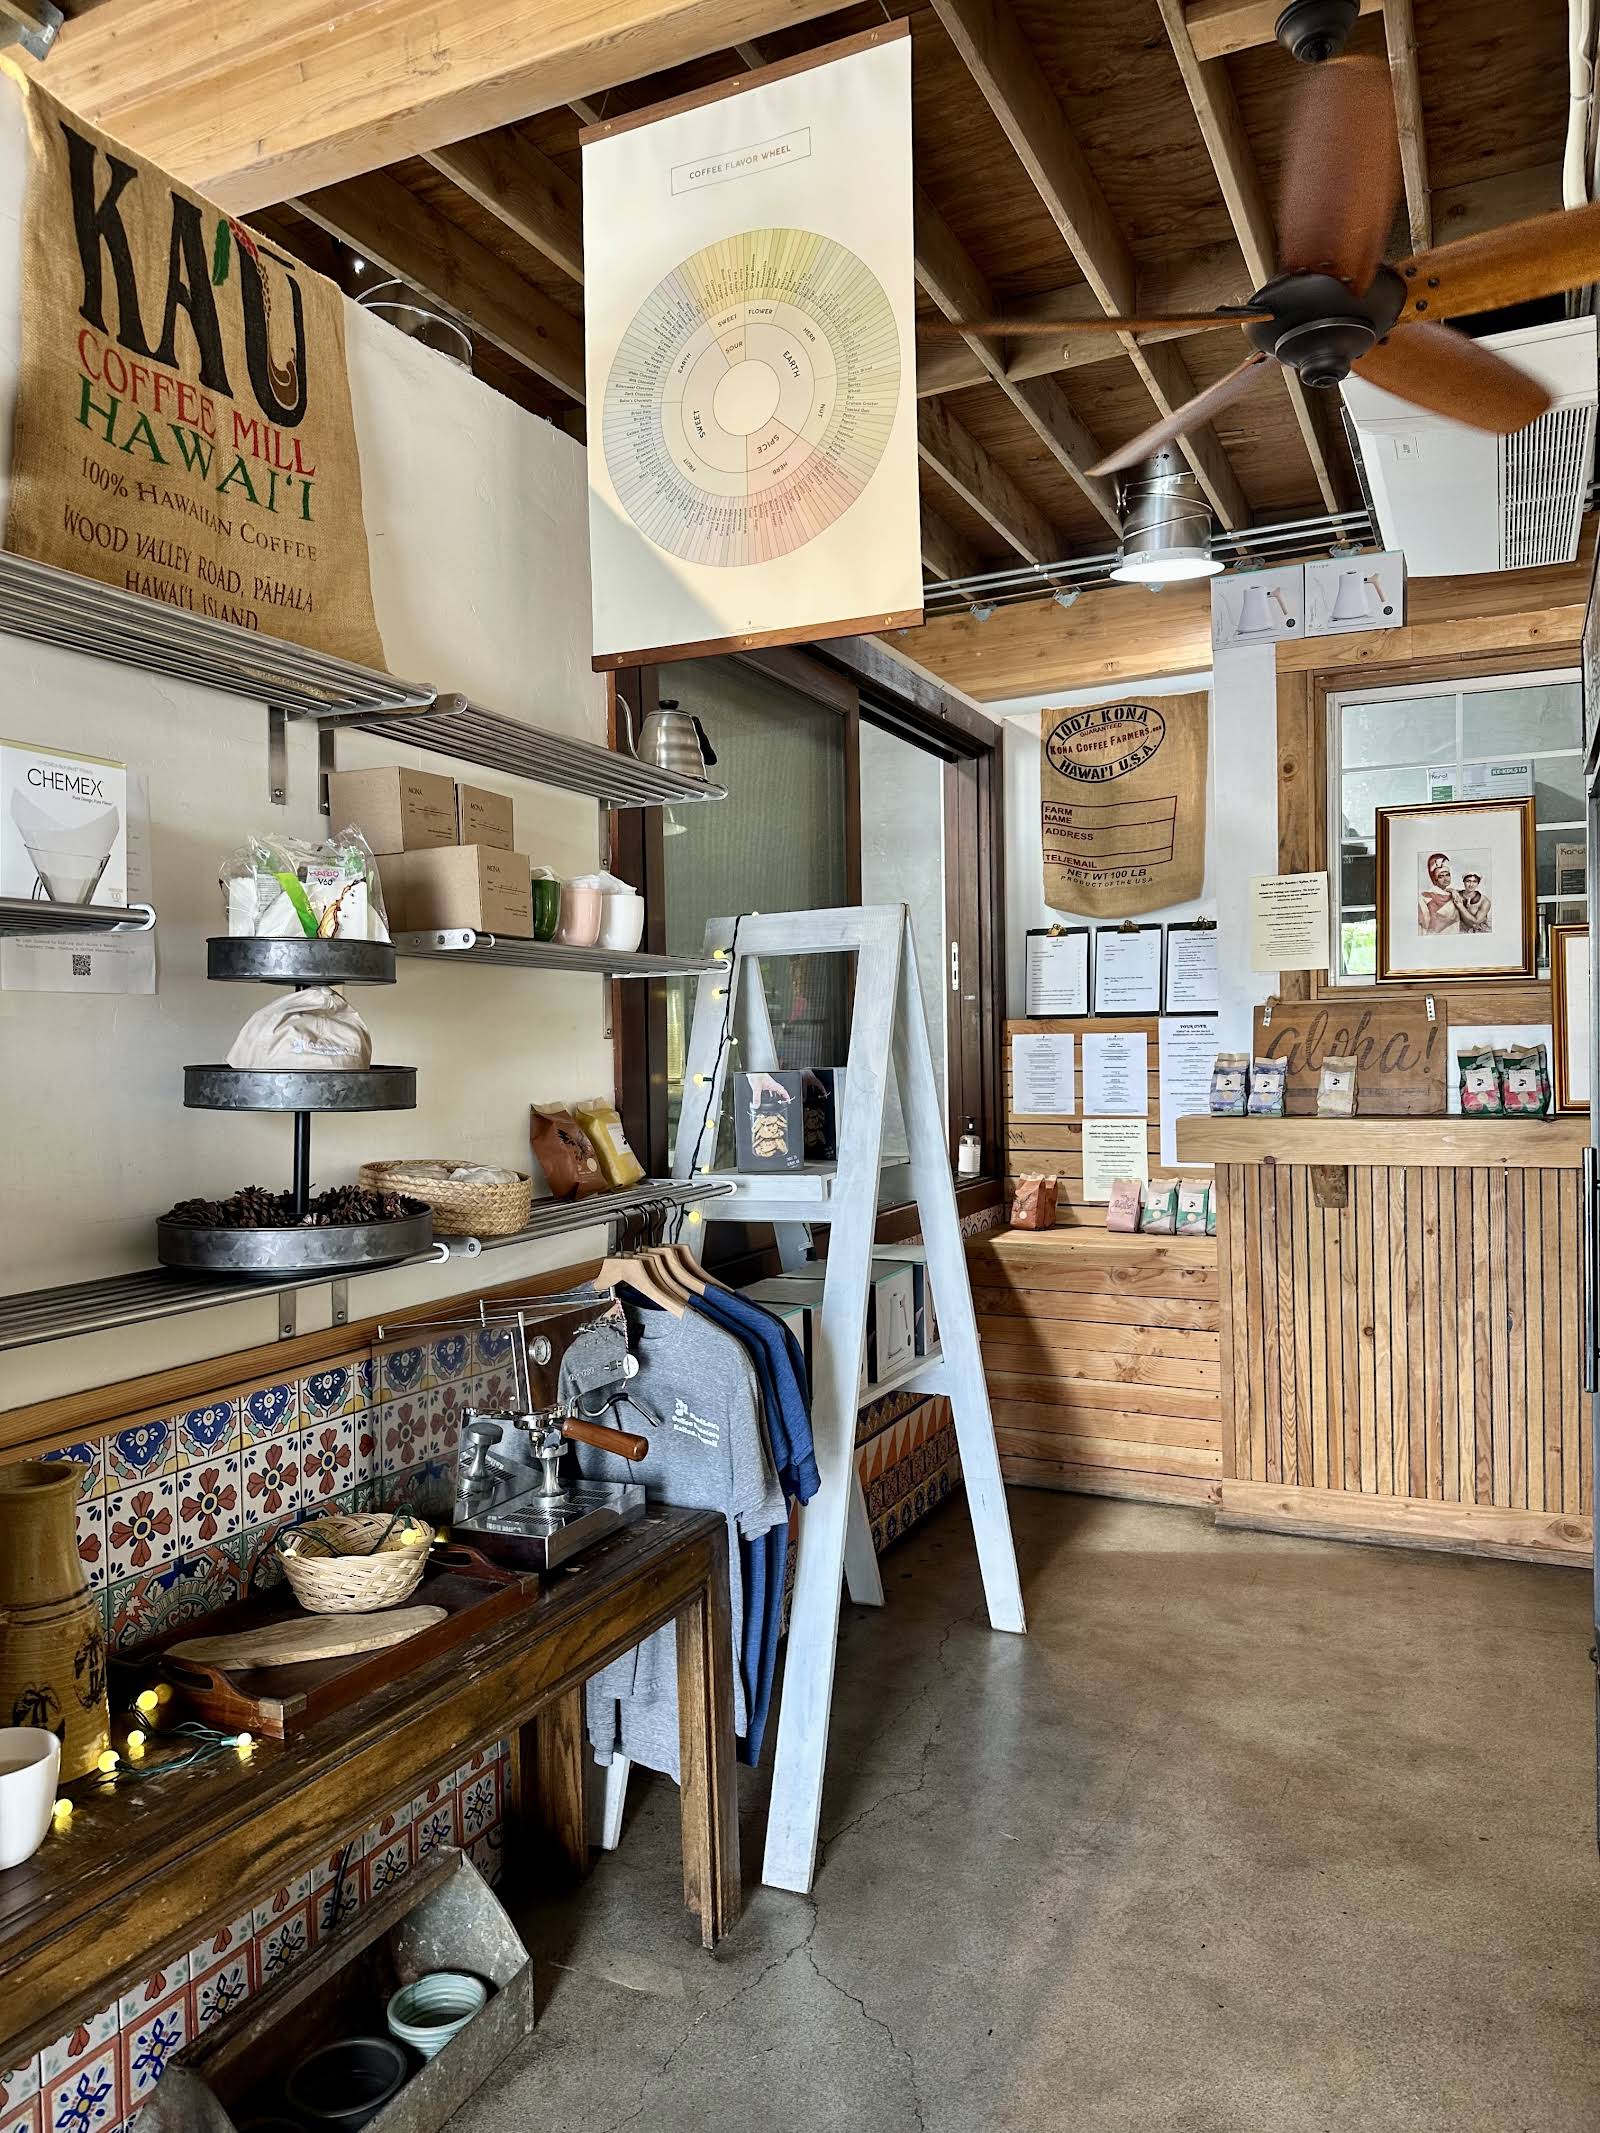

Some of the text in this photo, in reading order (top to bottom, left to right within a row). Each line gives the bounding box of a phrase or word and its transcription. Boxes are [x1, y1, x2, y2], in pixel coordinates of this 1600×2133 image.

[689, 144, 791, 180] COFFEE FLAVOR WHEEL
[718, 314, 737, 327] SWEET
[803, 328, 816, 342] HERB
[725, 341, 743, 353] SOUR
[678, 353, 692, 374] EARTH
[783, 350, 800, 378] EARTH
[78, 329, 315, 477] COFFEE MILL
[818, 404, 826, 418] NUT
[693, 410, 706, 438] SWEET
[757, 434, 780, 454] SPICE
[772, 461, 789, 475] HERB
[81, 456, 317, 562] 100% HAWAIIAN COFFEE
[64, 504, 129, 553] WOOD
[136, 533, 191, 574] VALLEY
[199, 555, 244, 597] ROAD,
[202, 592, 259, 632] ISLAND
[1054, 707, 1148, 741] 100% KONA
[1080, 723, 1122, 737] GUARANTEED
[1050, 745, 1073, 755] KONA
[1076, 740, 1109, 753] COFFEE
[1118, 744, 1157, 771] U.S.A.
[27, 768, 103, 798] CHEMEX
[1045, 806, 1073, 816] FARM
[1044, 814, 1073, 824] NAME
[1045, 827, 1094, 841] ADDRESS
[1045, 854, 1098, 869] TEL/EMAIL
[317, 878, 333, 886] V60
[1060, 875, 1102, 888] PRODUCT
[1135, 876, 1153, 885] USA
[1066, 868, 1147, 881] NET WT 100 LB
